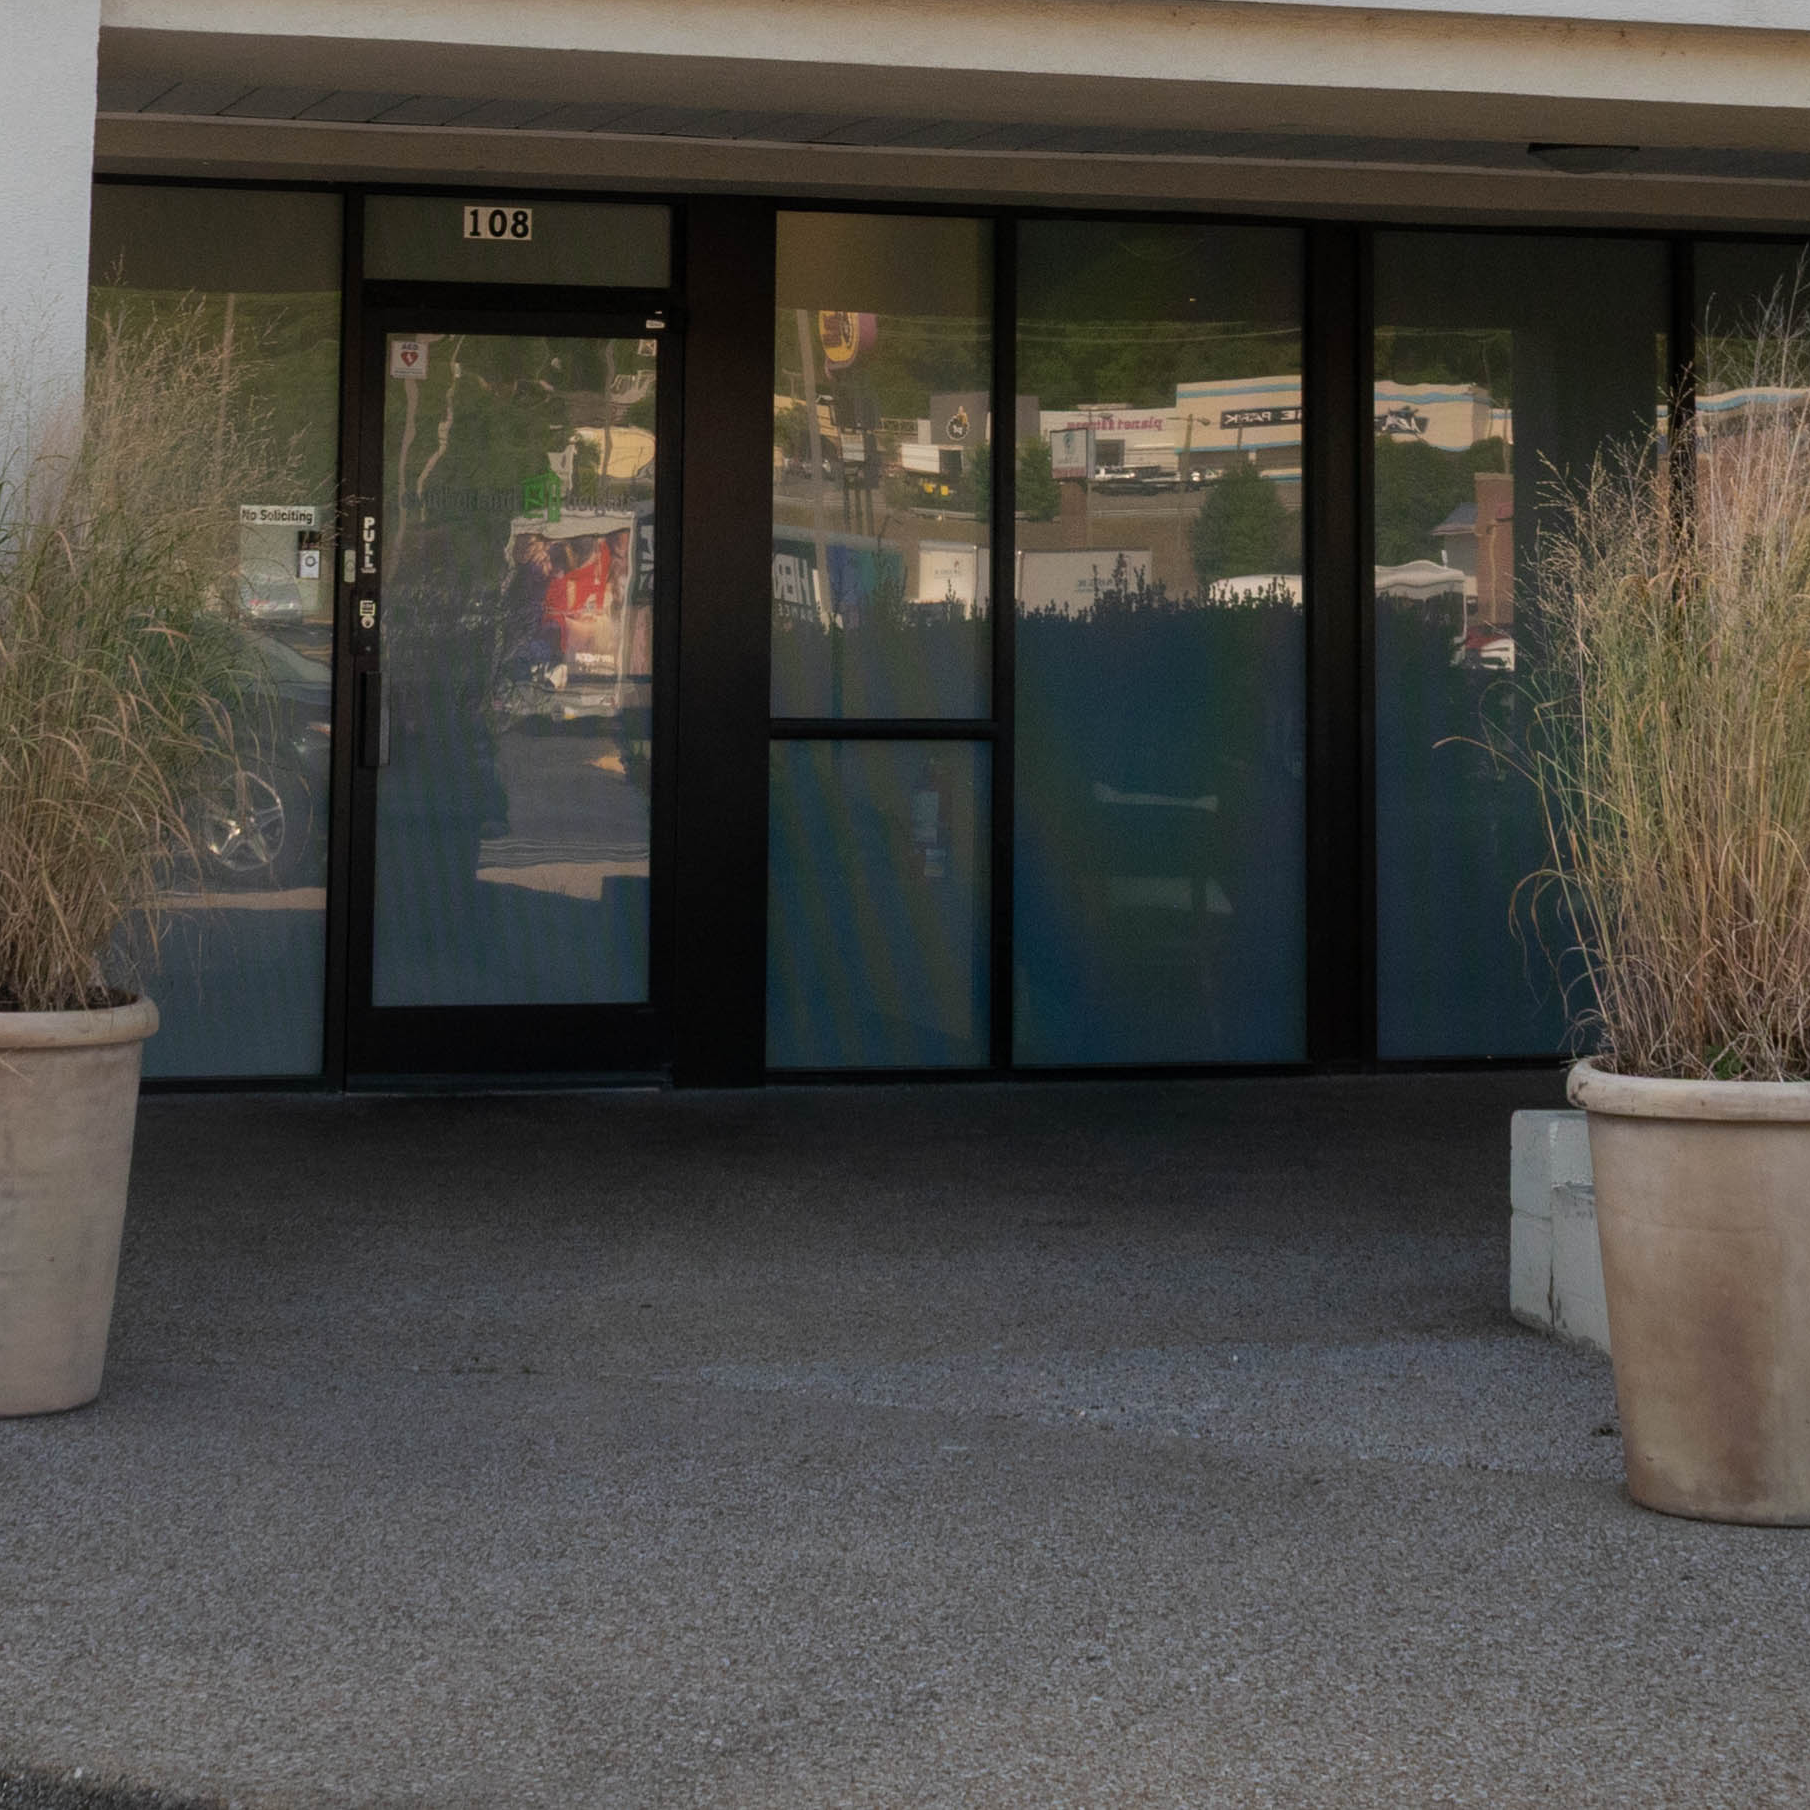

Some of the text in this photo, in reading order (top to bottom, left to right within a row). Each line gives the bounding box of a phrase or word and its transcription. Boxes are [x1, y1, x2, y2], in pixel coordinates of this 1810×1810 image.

[469, 208, 530, 239] 108
[242, 509, 314, 525] No Soliciting
[362, 516, 376, 568] PULL
